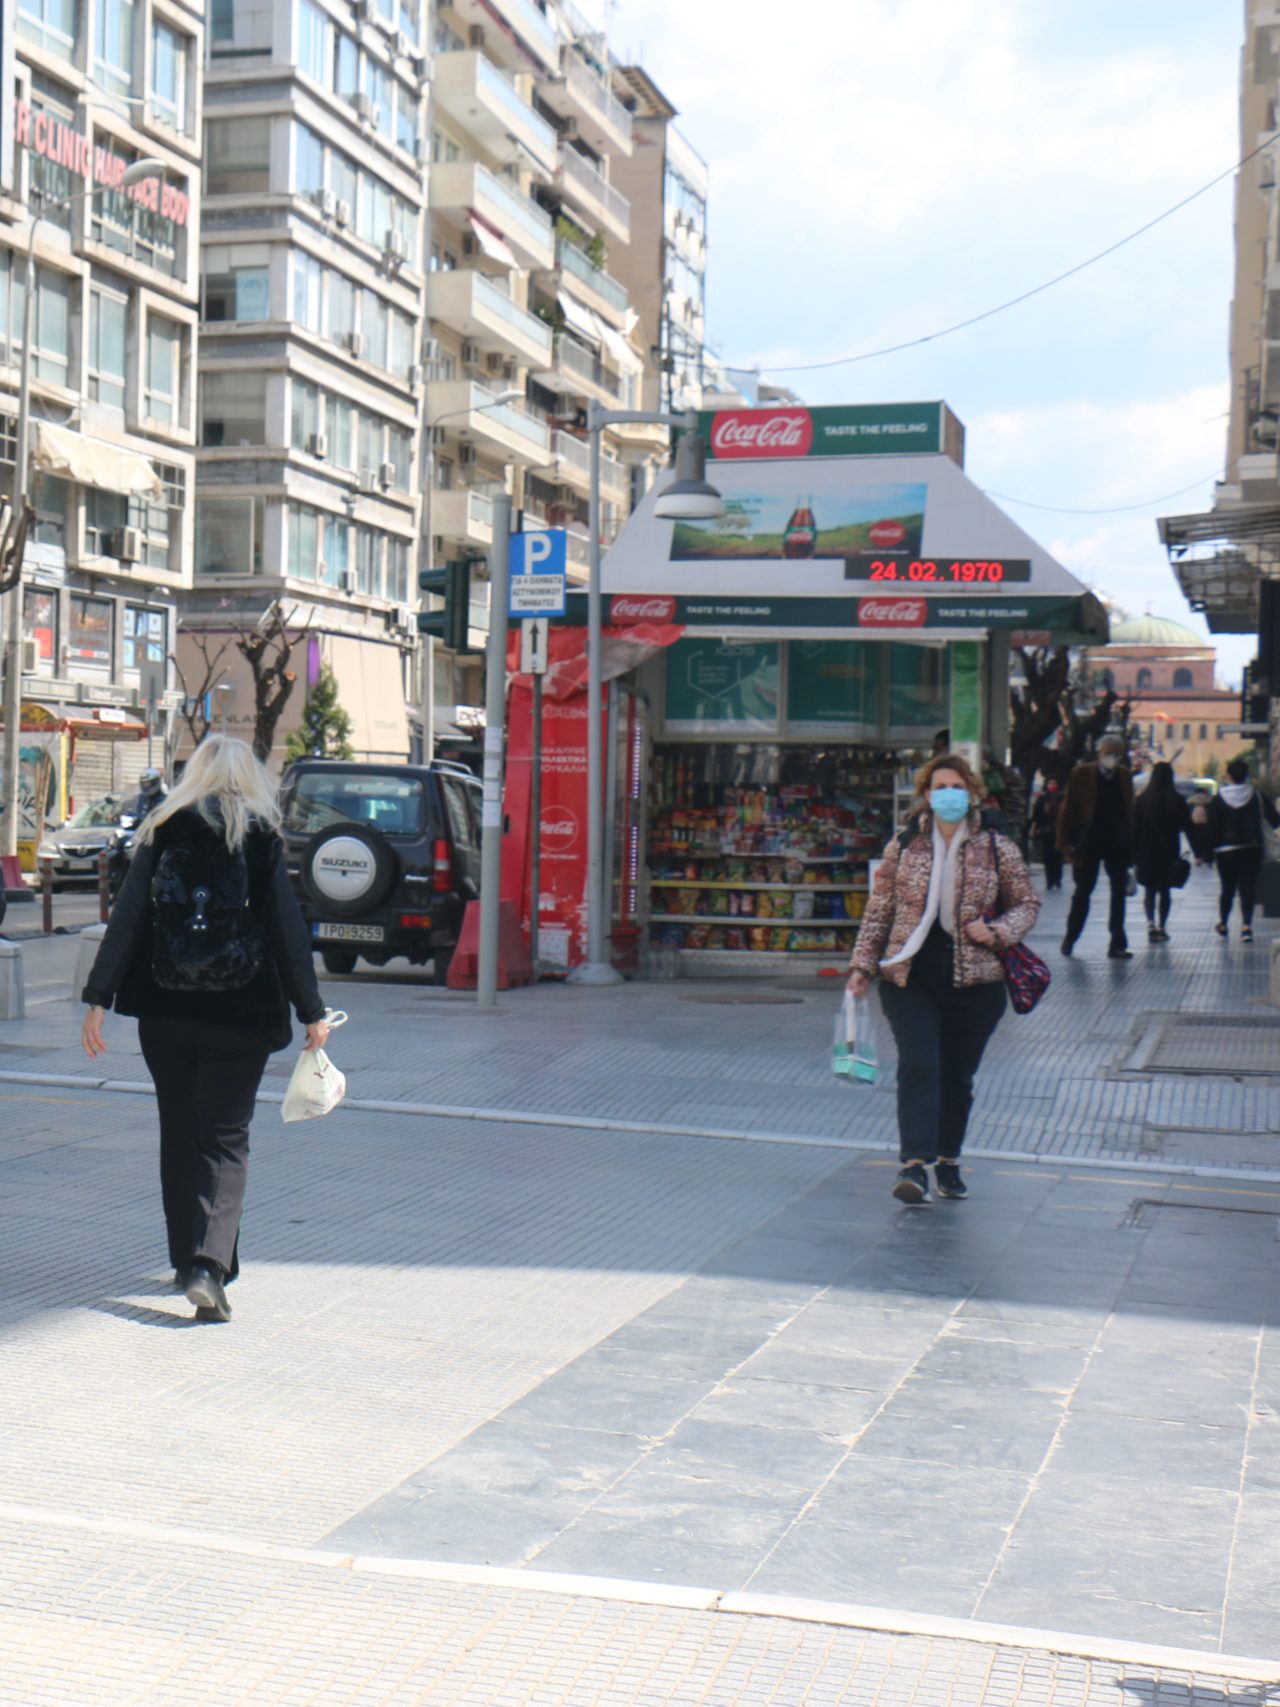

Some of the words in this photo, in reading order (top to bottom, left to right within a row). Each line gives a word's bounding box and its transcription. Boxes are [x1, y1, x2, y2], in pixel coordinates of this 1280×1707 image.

[35, 111, 91, 178] CLINIC
[715, 416, 806, 448] Coca-Cola
[825, 425, 857, 436] TASTE
[860, 425, 880, 435] THE
[882, 423, 928, 434] FEELING
[524, 532, 552, 575] P
[870, 561, 1003, 582] 24.02.1970
[611, 599, 671, 617] Coca-Cola
[686, 606, 713, 615] TASTE
[715, 606, 731, 614] THE
[733, 606, 771, 615] FEELING
[859, 601, 923, 621] Coca-Cola
[938, 608, 968, 618] TASTE
[969, 608, 987, 618] THE
[988, 609, 1028, 618] FEELING
[321, 857, 368, 869] SUZUKI
